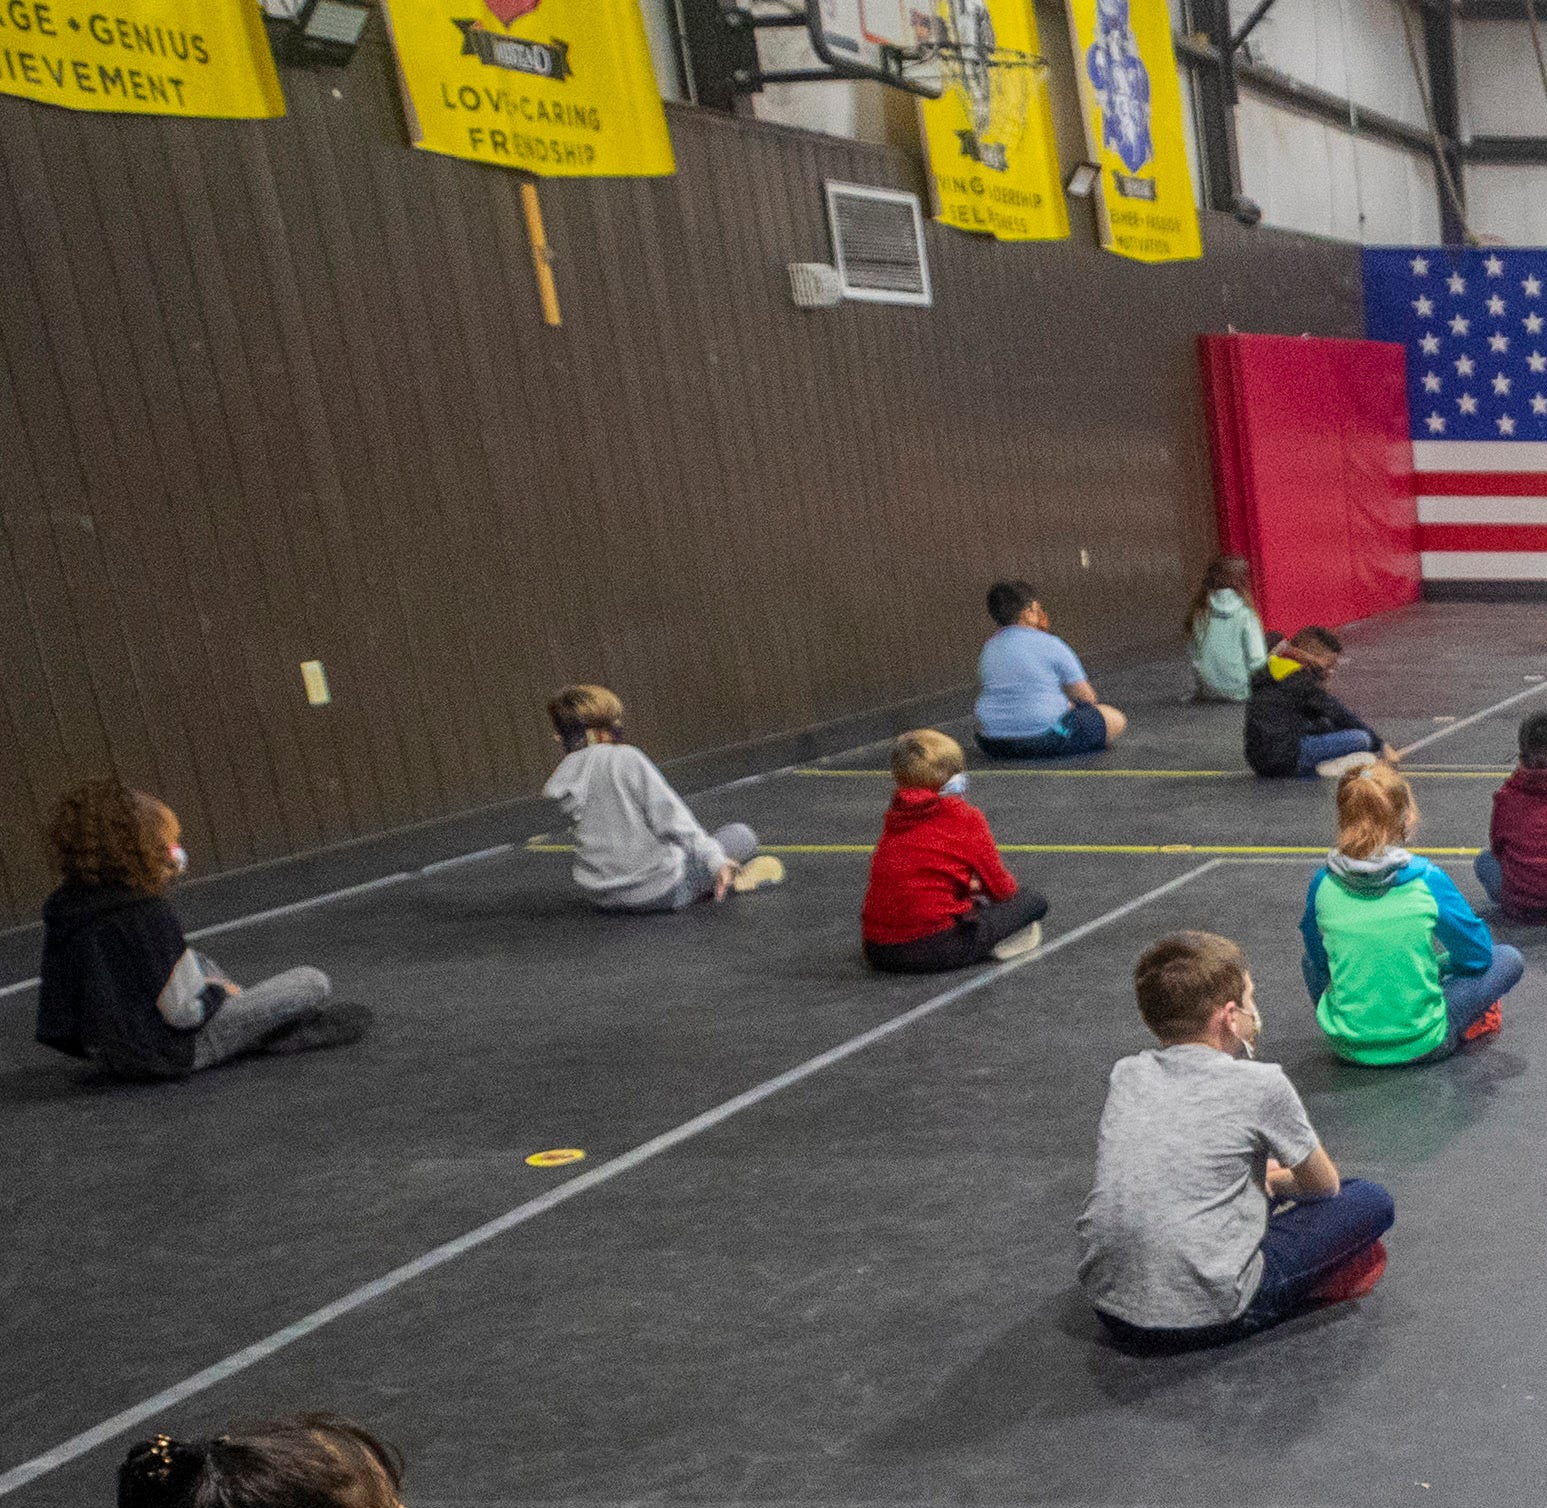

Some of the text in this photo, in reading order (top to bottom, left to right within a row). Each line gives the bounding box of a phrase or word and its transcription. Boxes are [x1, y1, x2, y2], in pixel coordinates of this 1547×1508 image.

[0, 0, 209, 65] GE GENIUS
[0, 48, 186, 108] IEVEMENT
